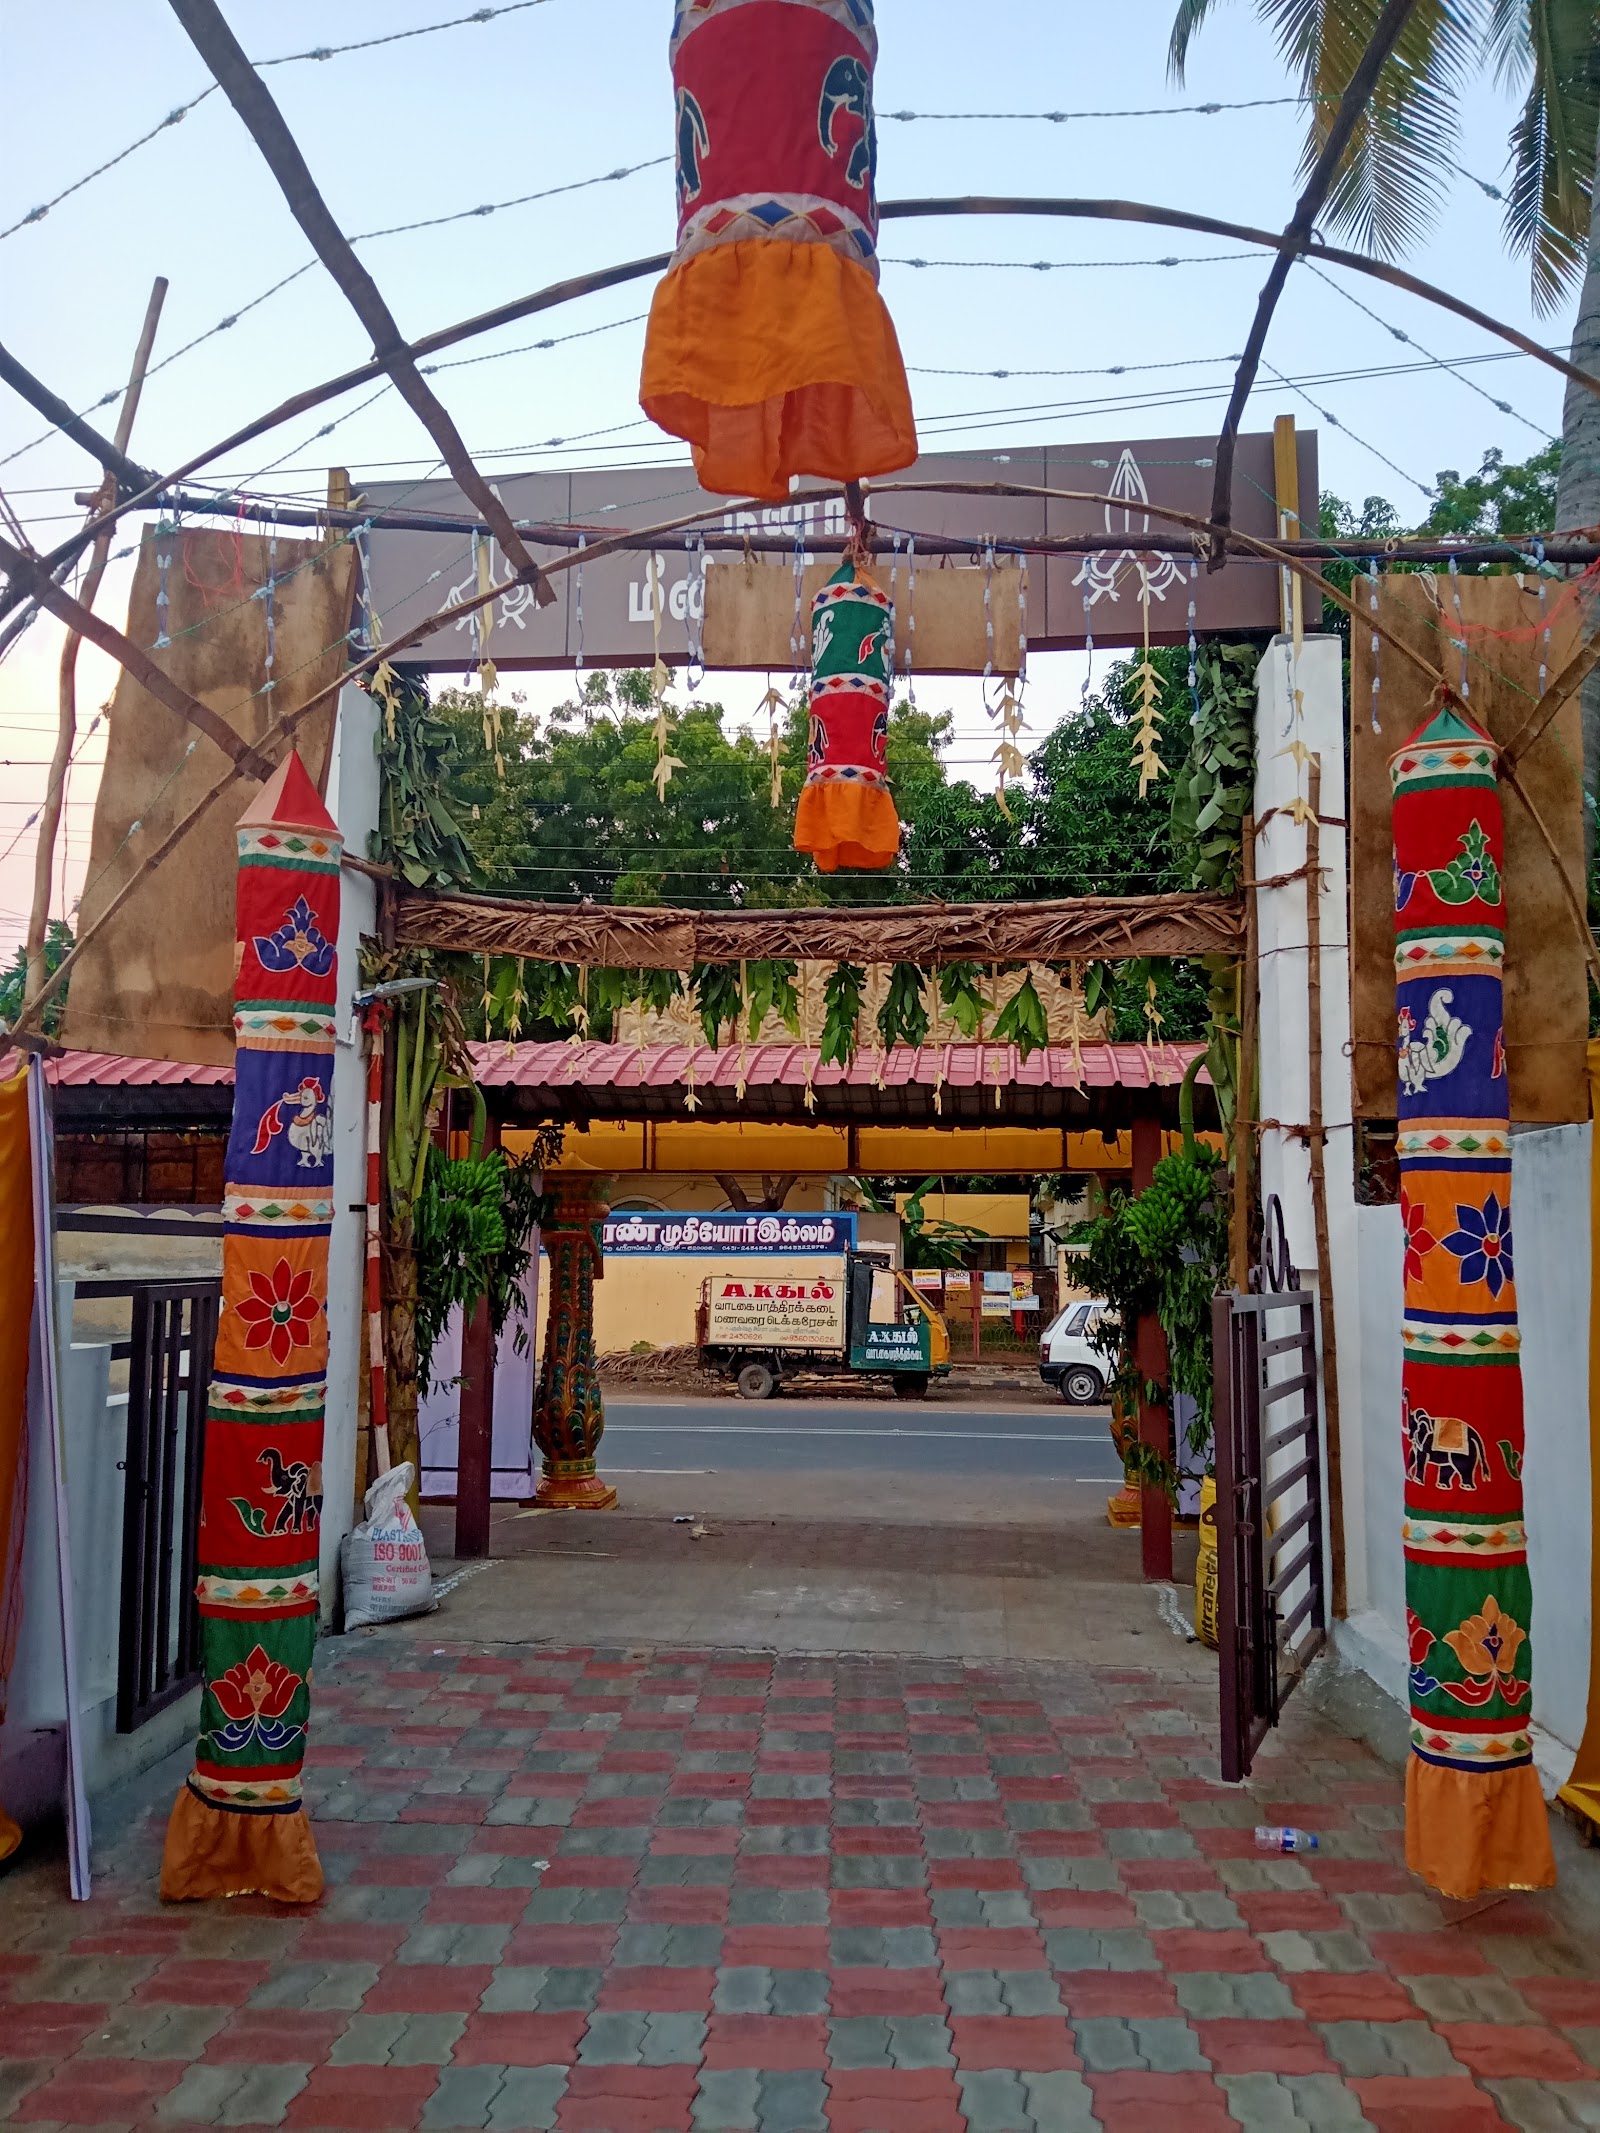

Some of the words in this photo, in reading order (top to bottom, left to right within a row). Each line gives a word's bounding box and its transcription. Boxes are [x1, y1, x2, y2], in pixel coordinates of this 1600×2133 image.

[374, 1543, 395, 1561] ISO
[399, 1543, 422, 1561] 9001
[386, 1564, 417, 1573] Certified
